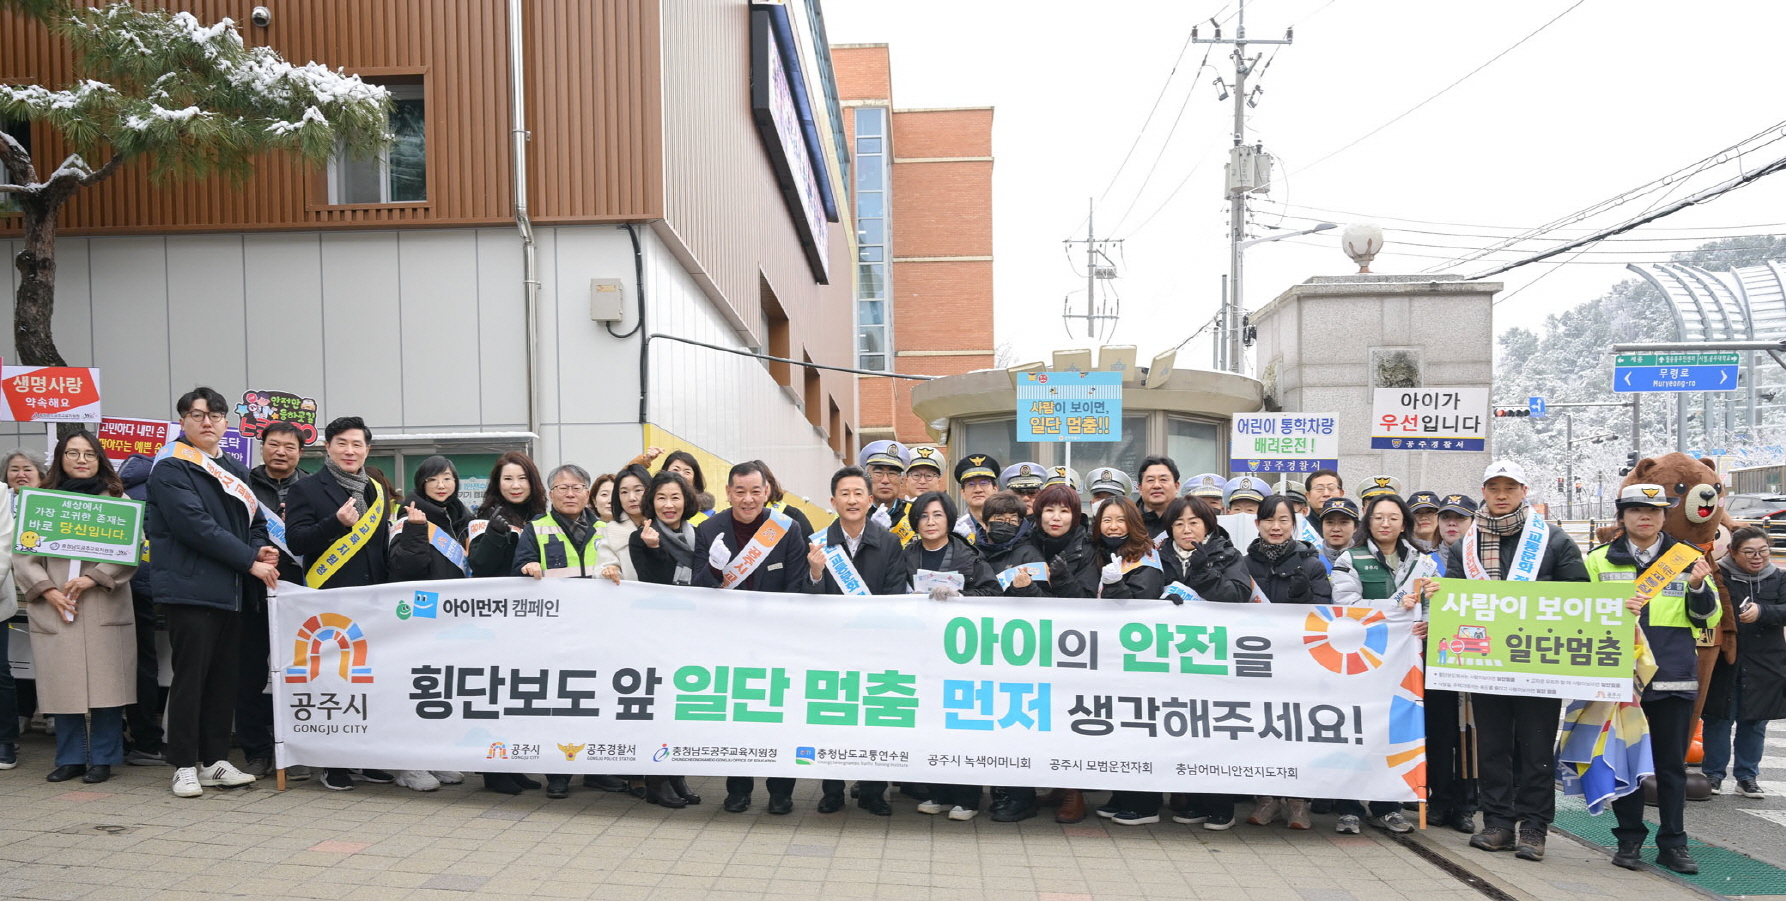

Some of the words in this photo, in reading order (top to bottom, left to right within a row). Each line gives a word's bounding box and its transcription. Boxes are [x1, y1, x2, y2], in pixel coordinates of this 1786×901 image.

[1659, 368, 1690, 379] 무령로
[13, 376, 82, 394] 생명사랑
[1653, 380, 1696, 388] Muryeong-ro
[25, 397, 70, 408] 약속해요
[270, 396, 302, 410] 안전만
[1030, 401, 1066, 414] 사람이
[1070, 401, 1110, 414] 보이면,
[1401, 392, 1461, 410] 아이가
[100, 423, 134, 436] 고민하다
[136, 424, 155, 438] 내민
[156, 426, 166, 438] 손
[1030, 416, 1062, 434] 일단
[1066, 416, 1110, 434] 멈춤!!
[1237, 418, 1276, 435] 어린이
[1280, 418, 1335, 435] 통학차량
[1379, 414, 1481, 434] 우선입니다
[134, 440, 152, 454] 예쁜
[1406, 440, 1464, 449] 공주경찰서
[1262, 460, 1321, 472] 공주경찰서
[62, 500, 102, 513] 세상에서
[35, 506, 56, 518] 가장
[60, 510, 91, 522] 고귀한
[96, 514, 127, 526] 존재는
[28, 520, 54, 532] 바로
[60, 522, 128, 540] 당신입니다.
[734, 546, 762, 574] 공주시
[442, 598, 508, 618] 아이먼저
[512, 599, 560, 618] 캠페인
[1440, 592, 1528, 622] 사람이
[1536, 596, 1624, 626] 보이면
[943, 616, 1098, 670] 아이의
[1118, 622, 1274, 678] 안전을
[1504, 632, 1622, 667] 일단멈춤
[290, 692, 368, 722] 공주시
[408, 664, 600, 720] 횡단보도
[612, 668, 662, 720] 앞
[672, 665, 790, 724] 일단
[804, 669, 919, 728] 멈춤
[942, 678, 1052, 732] 먼저
[1067, 694, 1364, 745] 생각해주세요!
[292, 724, 338, 736] GONGJU
[342, 724, 368, 734] CITY
[510, 744, 540, 756] 공주시
[587, 744, 636, 756] 공주경찰서
[672, 746, 778, 758] 충청남도공주교육지원청
[817, 748, 909, 762] 충청남도교통연수원
[928, 754, 960, 767] 공주시
[964, 755, 1030, 769] 녹색어머니회
[1050, 758, 1082, 772] 공주시
[1086, 760, 1153, 774] 모범운전자회
[1176, 762, 1298, 780] 충남어머니안전지도자회
